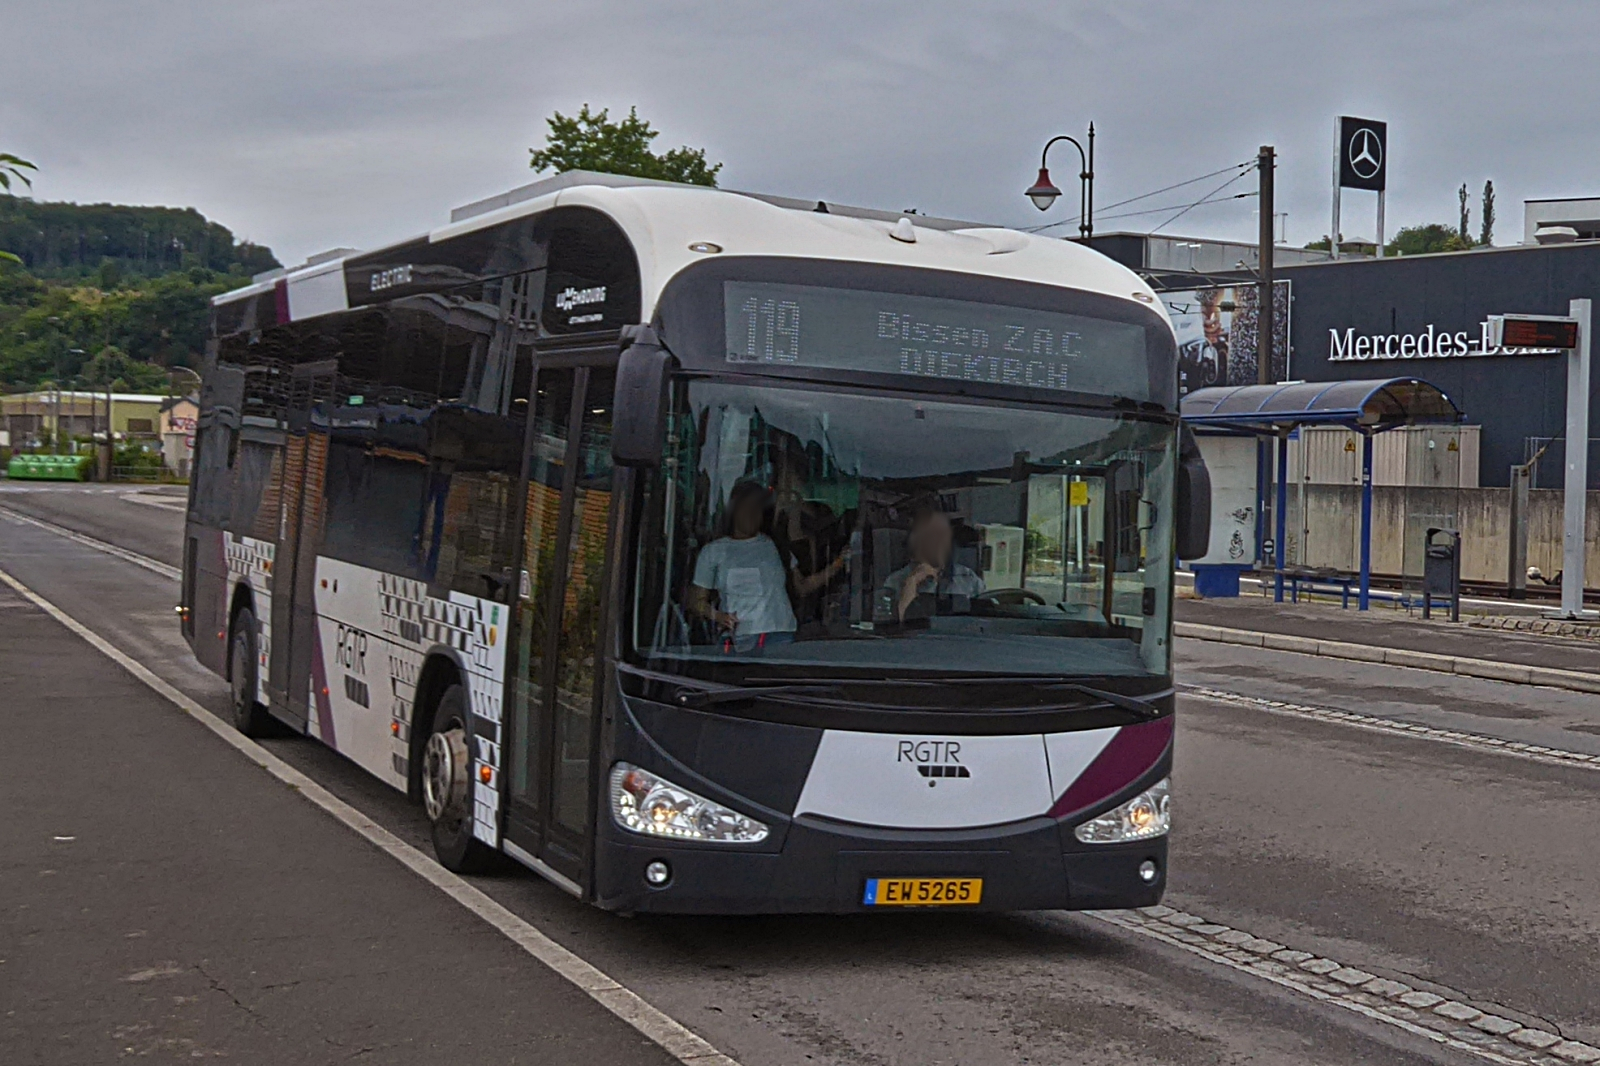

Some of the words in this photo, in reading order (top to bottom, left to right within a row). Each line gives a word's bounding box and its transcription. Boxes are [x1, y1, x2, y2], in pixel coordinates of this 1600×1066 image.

[742, 297, 800, 361] 119
[878, 311, 989, 348] Bissen
[900, 347, 1068, 388] DIEKIRCH
[335, 623, 368, 676] RGTR
[897, 740, 961, 763] RGTR
